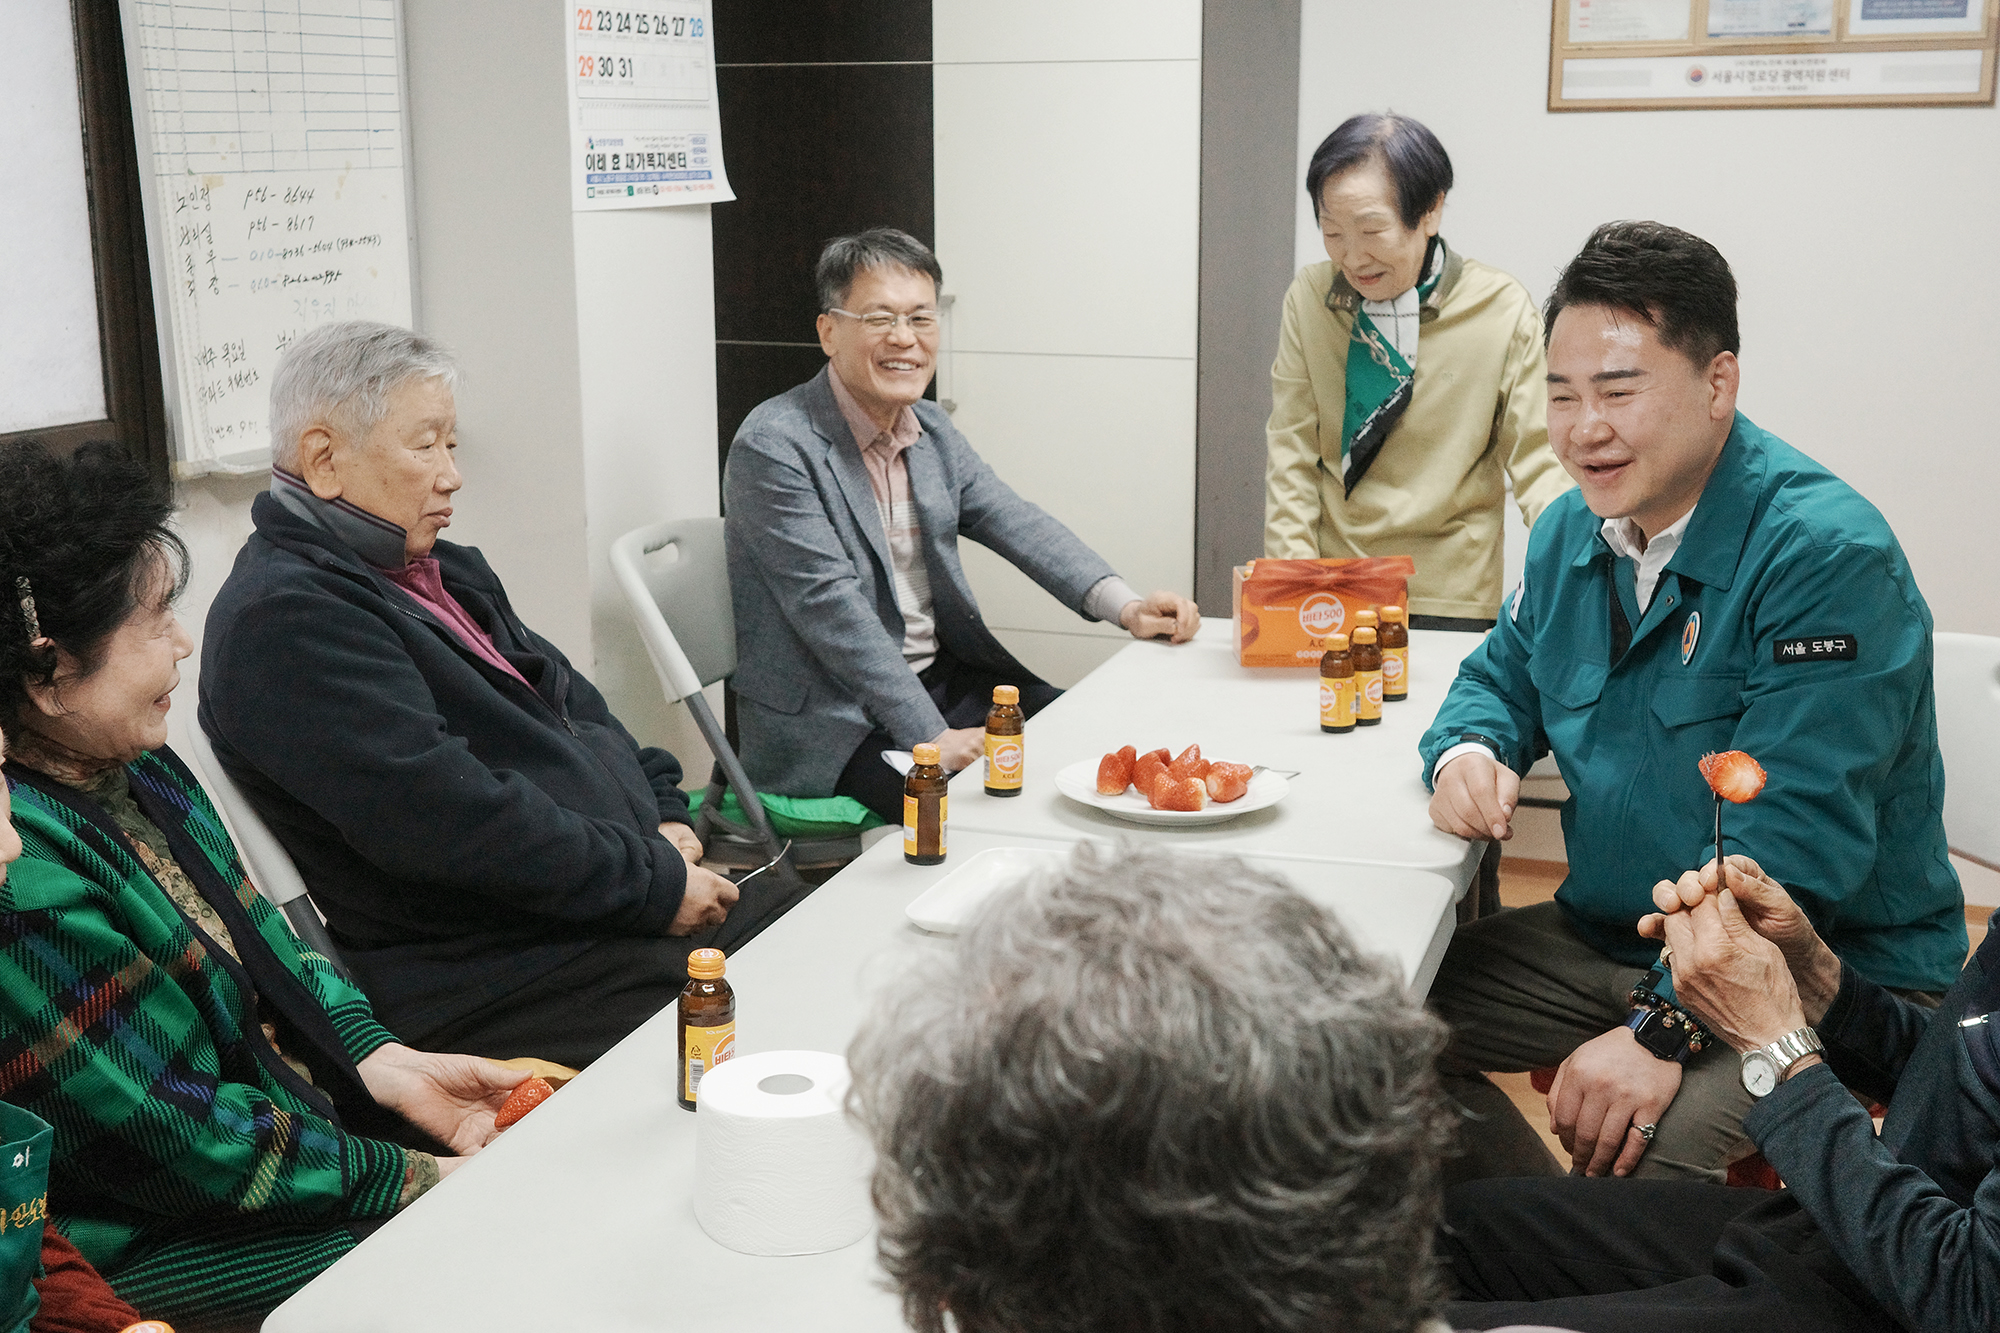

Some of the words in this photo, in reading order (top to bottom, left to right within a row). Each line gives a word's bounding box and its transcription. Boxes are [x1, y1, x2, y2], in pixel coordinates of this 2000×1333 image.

[577, 8, 593, 31] 22
[597, 10, 612, 32] 23
[616, 12, 631, 33] 24
[635, 14, 650, 34] 25
[653, 15, 669, 36] 26
[672, 17, 685, 37] 27
[689, 18, 704, 37] 28
[578, 55, 594, 77] 29
[598, 56, 614, 77] 30
[618, 57, 634, 78] 31
[1782, 642, 1807, 656] 서울
[1811, 639, 1847, 653] 도봉구
